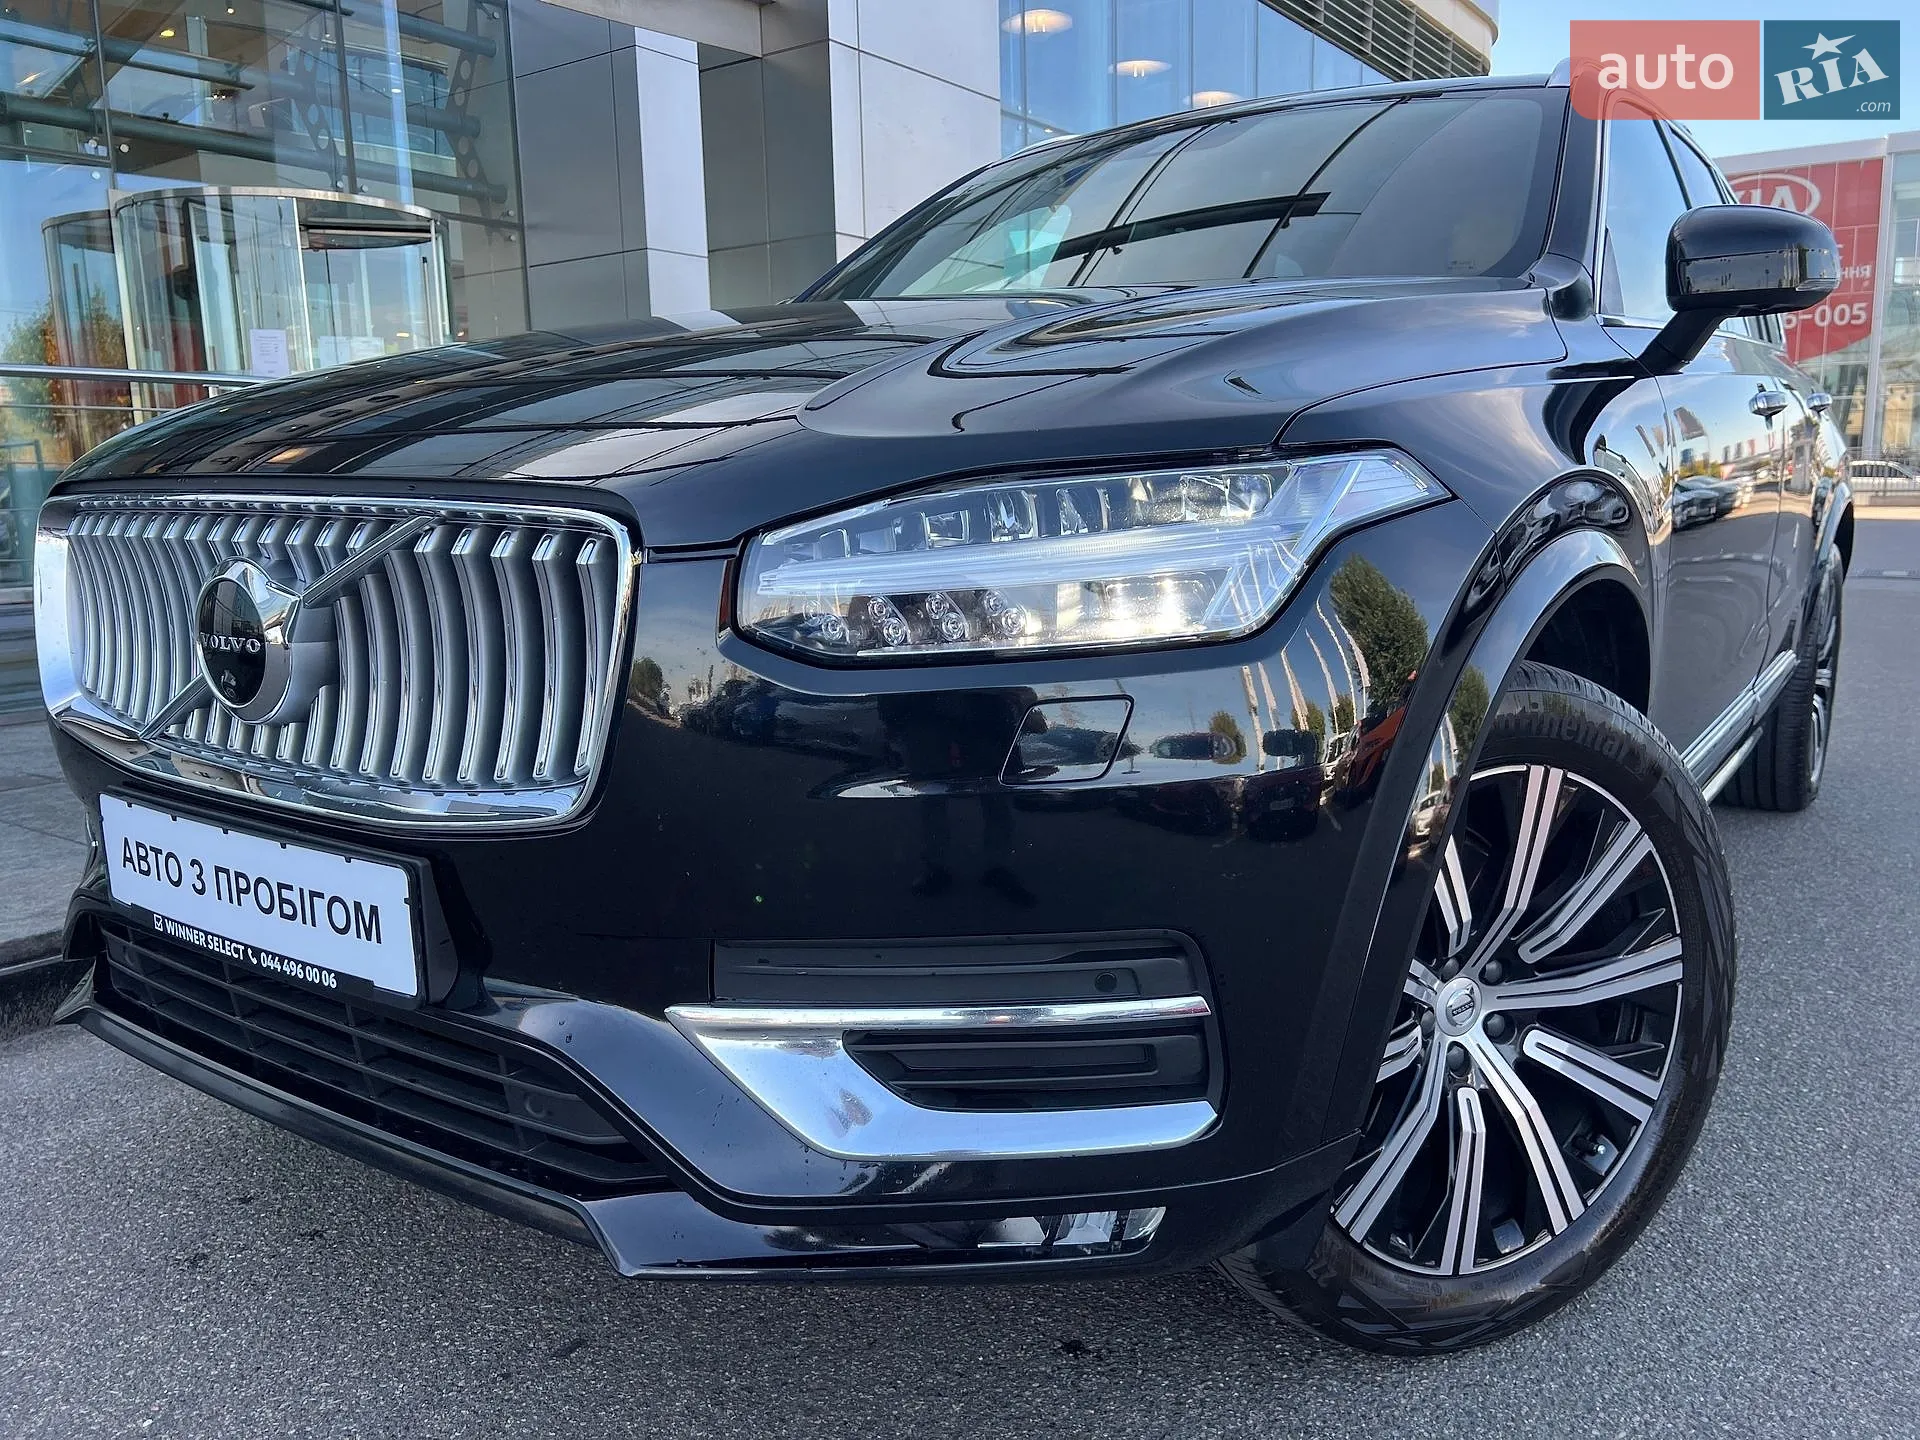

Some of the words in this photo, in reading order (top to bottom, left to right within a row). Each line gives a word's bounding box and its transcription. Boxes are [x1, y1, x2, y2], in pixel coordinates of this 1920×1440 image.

[1735, 185, 1797, 211] IA
[200, 632, 261, 653] VOLVO
[122, 836, 183, 888] АВТО
[214, 864, 382, 944] ПРОБІГОМ
[164, 918, 207, 948] WINNER
[207, 935, 245, 961] SELECT
[260, 951, 282, 973] 044
[282, 958, 304, 979] 496
[305, 965, 320, 984] 00
[321, 969, 337, 989] 06
